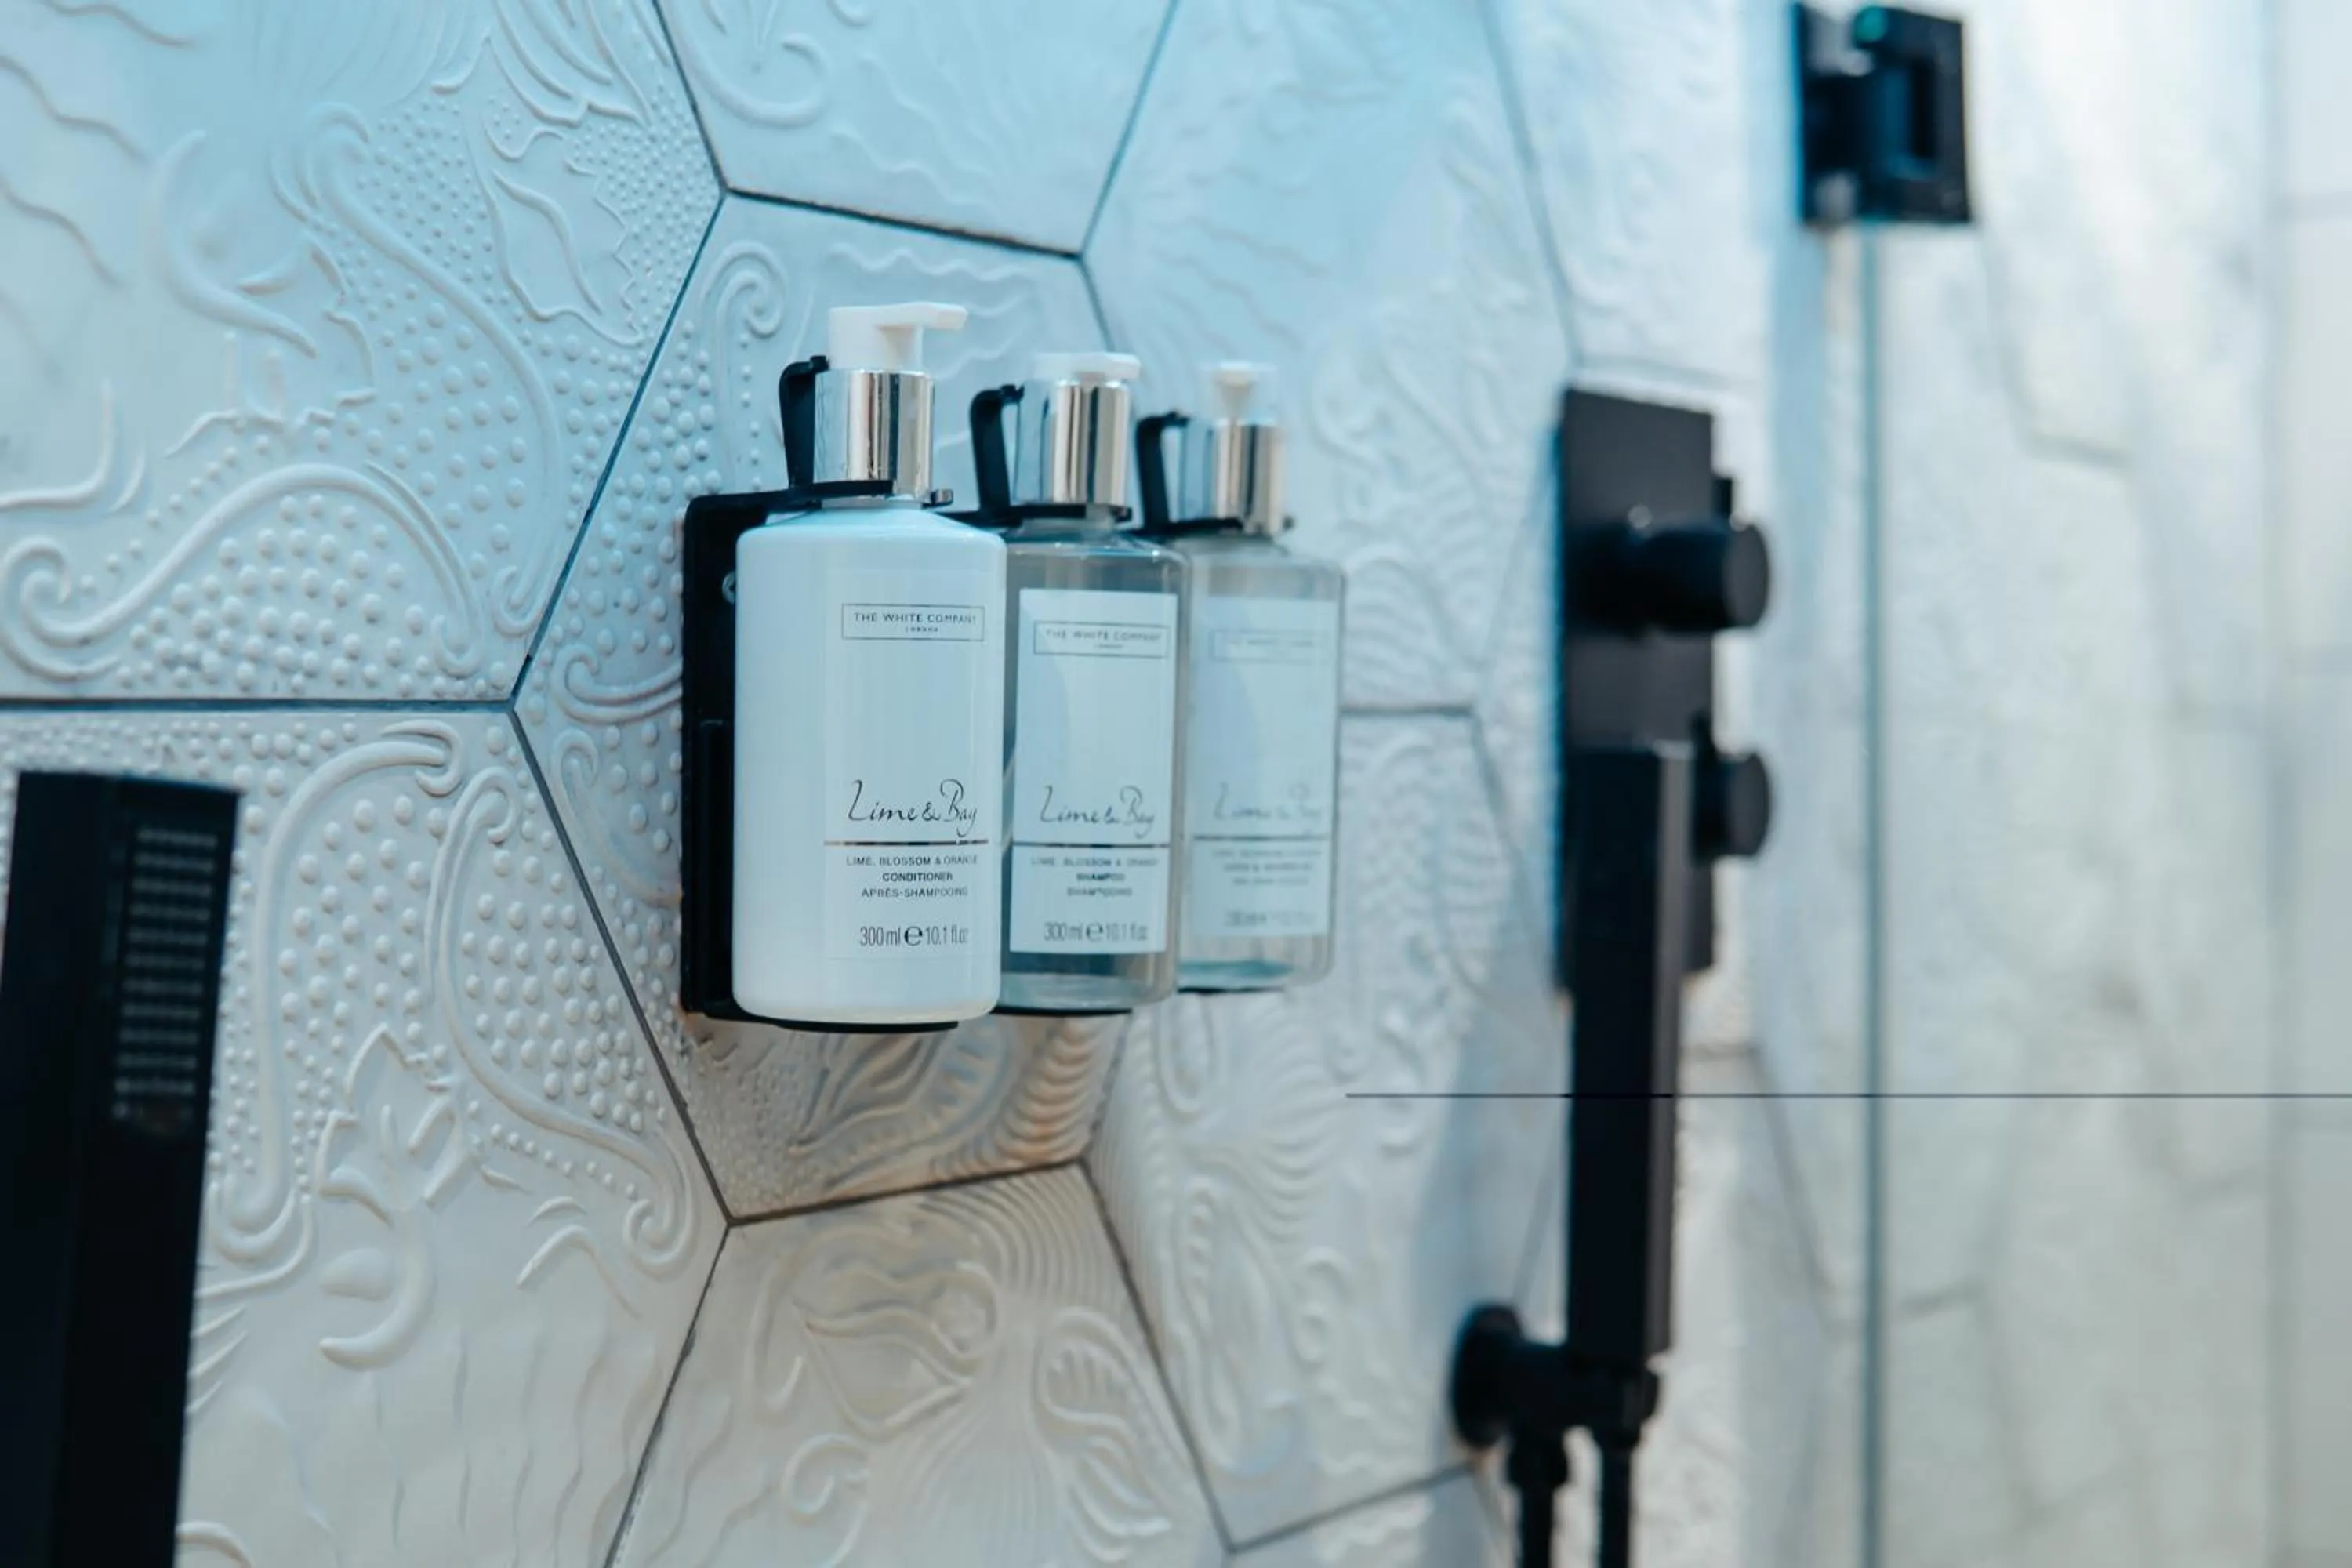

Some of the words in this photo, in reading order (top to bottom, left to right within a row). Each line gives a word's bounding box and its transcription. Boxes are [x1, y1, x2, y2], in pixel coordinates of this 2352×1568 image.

[854, 612, 877, 622] THE
[883, 613, 923, 623] WHITE
[927, 614, 977, 625] COMPANY
[879, 856, 931, 866] BLOSSOM
[882, 872, 953, 882] CONDITIONER
